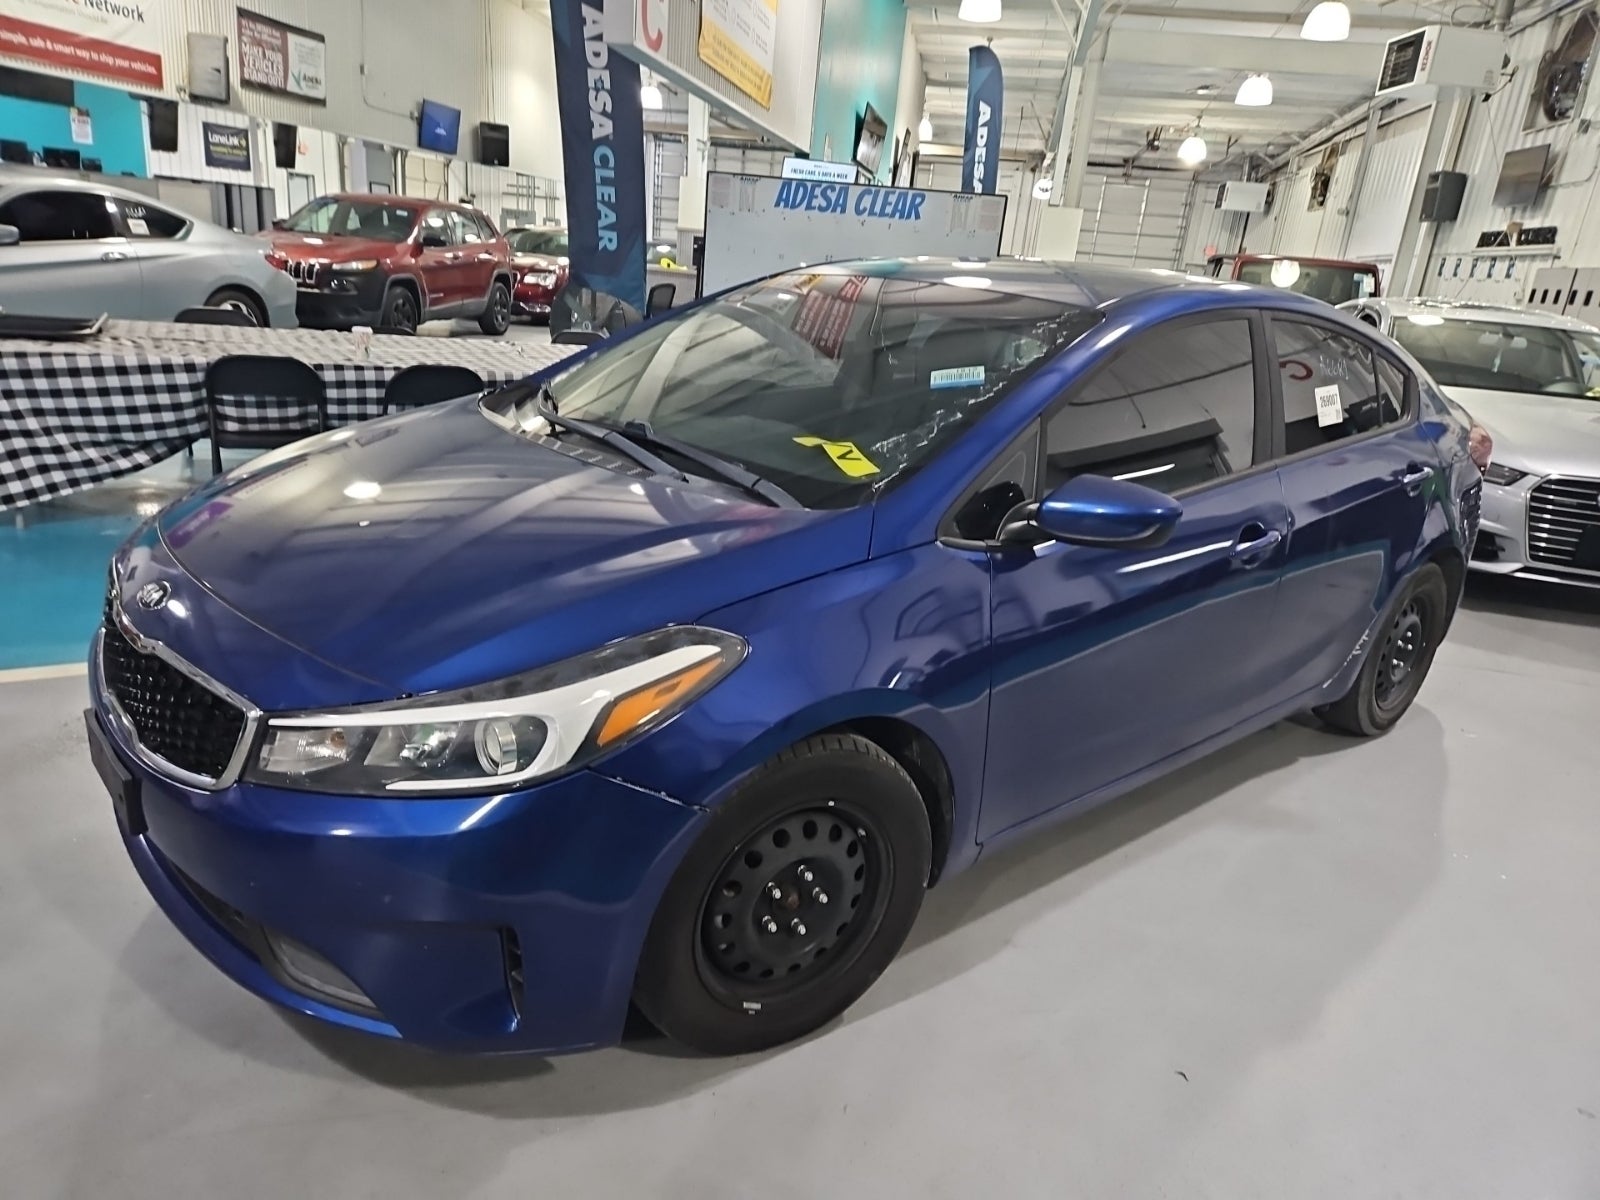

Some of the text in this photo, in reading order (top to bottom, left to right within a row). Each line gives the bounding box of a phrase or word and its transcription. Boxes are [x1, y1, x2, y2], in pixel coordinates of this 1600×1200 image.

[581, 2, 618, 251] ADESA CLEAR
[774, 180, 926, 220] ADESA CLEAR
